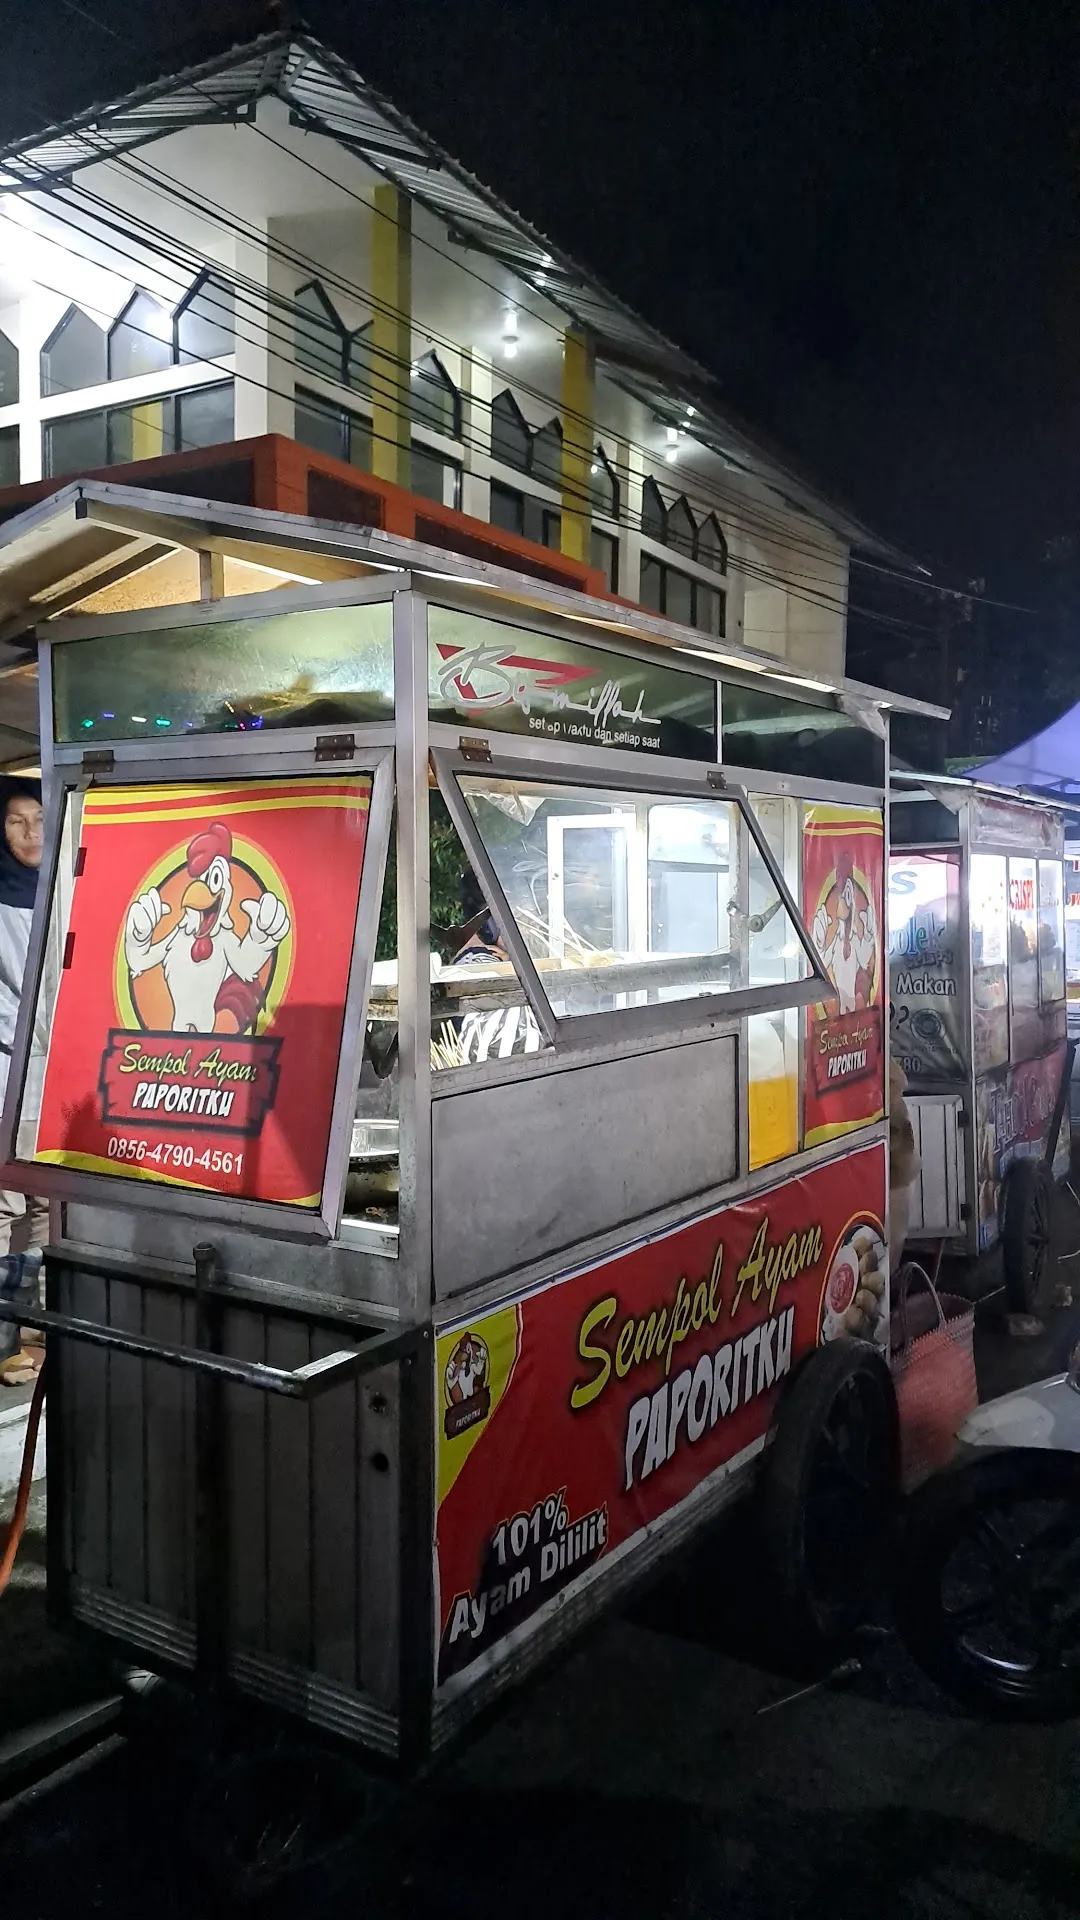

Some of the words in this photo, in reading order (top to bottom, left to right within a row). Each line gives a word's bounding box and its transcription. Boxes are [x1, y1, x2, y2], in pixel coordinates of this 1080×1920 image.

[594, 726, 611, 741] dan
[614, 731, 640, 747] setiap
[642, 736, 661, 748] saat
[896, 972, 956, 996] Makan
[120, 1044, 192, 1080] Sempol
[194, 1049, 257, 1086] Ayam
[828, 1049, 867, 1078] PAPORITKU
[133, 1083, 234, 1117] PAPORITKU
[107, 1137, 243, 1175] 0856-4790-4561
[571, 1244, 722, 1408] Sempol
[733, 1217, 822, 1313] Ayam
[624, 1305, 795, 1490] PAPORITKU
[493, 1494, 567, 1565] 101%
[449, 1566, 531, 1644] Ayam
[540, 1511, 606, 1582] Dililit
